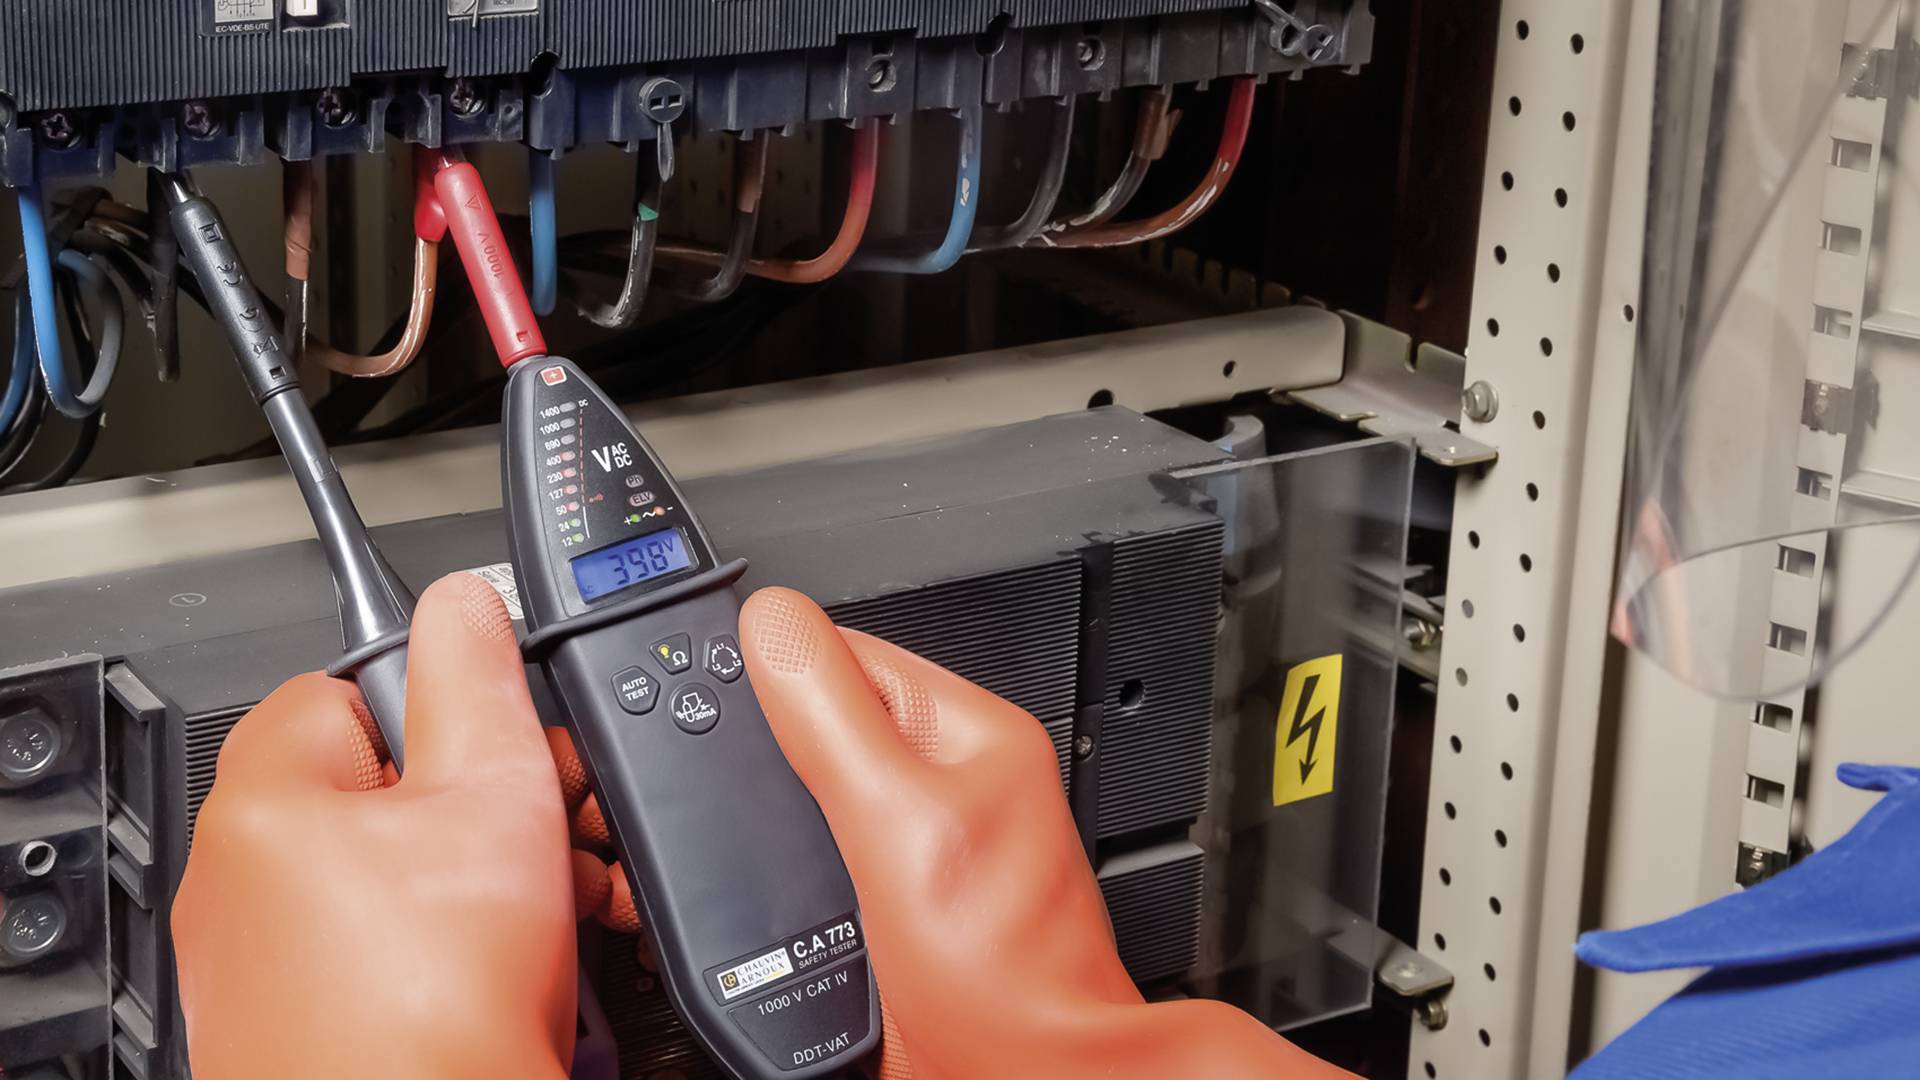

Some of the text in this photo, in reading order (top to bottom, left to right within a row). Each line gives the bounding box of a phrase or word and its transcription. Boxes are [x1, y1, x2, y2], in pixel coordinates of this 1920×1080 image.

[578, 399, 589, 407] DC
[540, 406, 560, 419] 1400
[540, 422, 560, 435] 1000
[544, 438, 561, 451] 690
[546, 455, 562, 466] 400
[591, 442, 627, 472] V AC
[614, 454, 632, 468] DC
[547, 471, 563, 484] 230
[548, 488, 563, 500] 127
[555, 504, 567, 516] 50
[558, 521, 570, 532] 24
[562, 536, 573, 547] 12
[622, 676, 647, 692] AUTO
[625, 686, 649, 701] TEST
[825, 921, 856, 946] 773
[798, 938, 857, 969] SAFETY TESTER
[740, 963, 785, 986] ARNOUX
[758, 970, 848, 1015] 1000 V CAT IV
[793, 1032, 850, 1064] DDT-VAT
